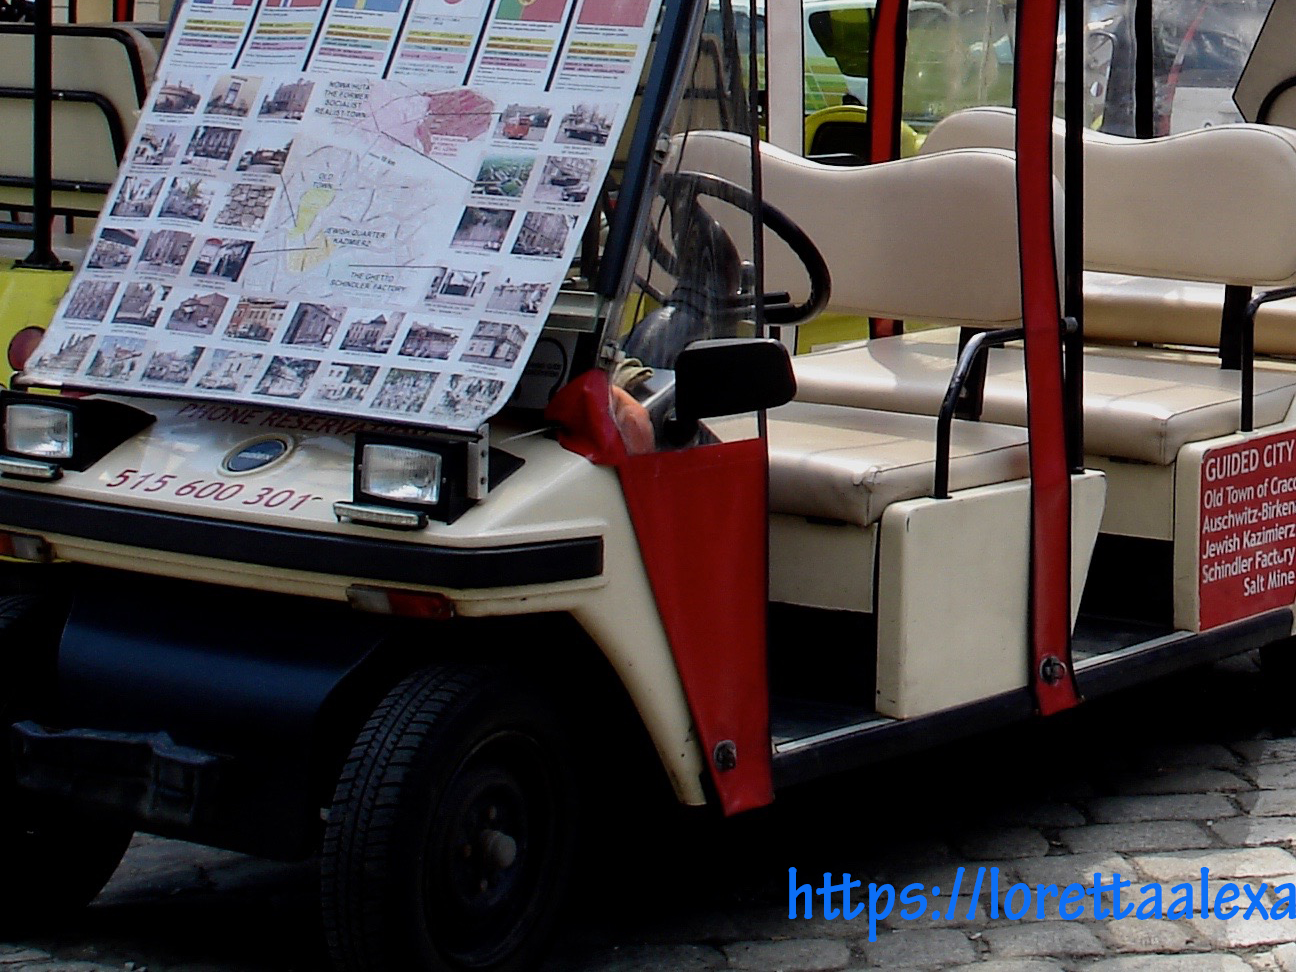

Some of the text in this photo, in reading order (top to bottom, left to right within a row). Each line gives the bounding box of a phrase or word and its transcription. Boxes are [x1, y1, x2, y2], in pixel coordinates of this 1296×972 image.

[324, 89, 338, 98] THE
[174, 402, 263, 426] PHONE
[1205, 448, 1260, 482] GUIDED
[1263, 438, 1295, 469] CITY
[105, 468, 317, 512] 515 600 301
[1203, 486, 1224, 510] Old
[1225, 484, 1254, 505] Town
[1256, 478, 1269, 497] of
[1202, 523, 1296, 560] Jewish Kazimierz
[1202, 555, 1253, 584] Schindler
[1243, 569, 1296, 597] Salt Mine
